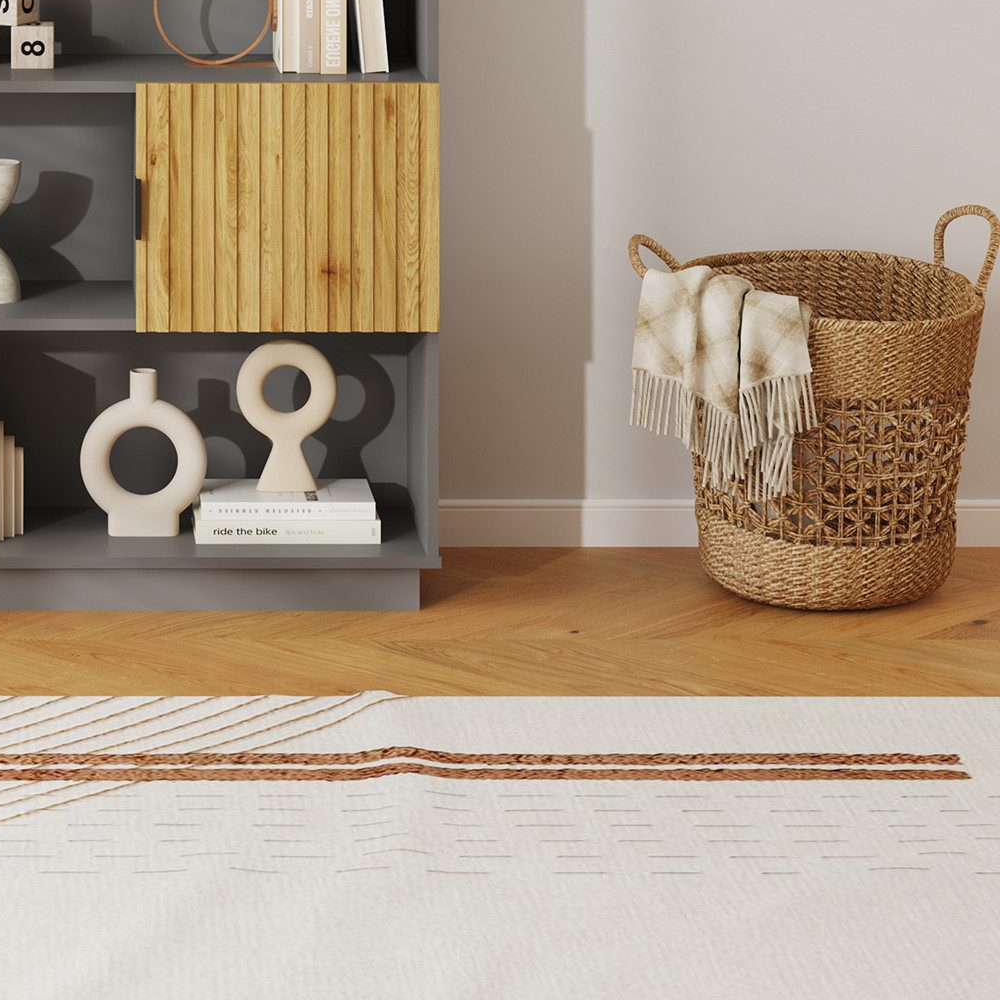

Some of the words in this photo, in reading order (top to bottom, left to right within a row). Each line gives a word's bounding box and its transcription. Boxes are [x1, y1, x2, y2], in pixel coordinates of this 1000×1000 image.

[20, 40, 45, 56] 8
[213, 527, 233, 536] ride
[236, 527, 253, 536] the
[256, 527, 278, 536] bike
